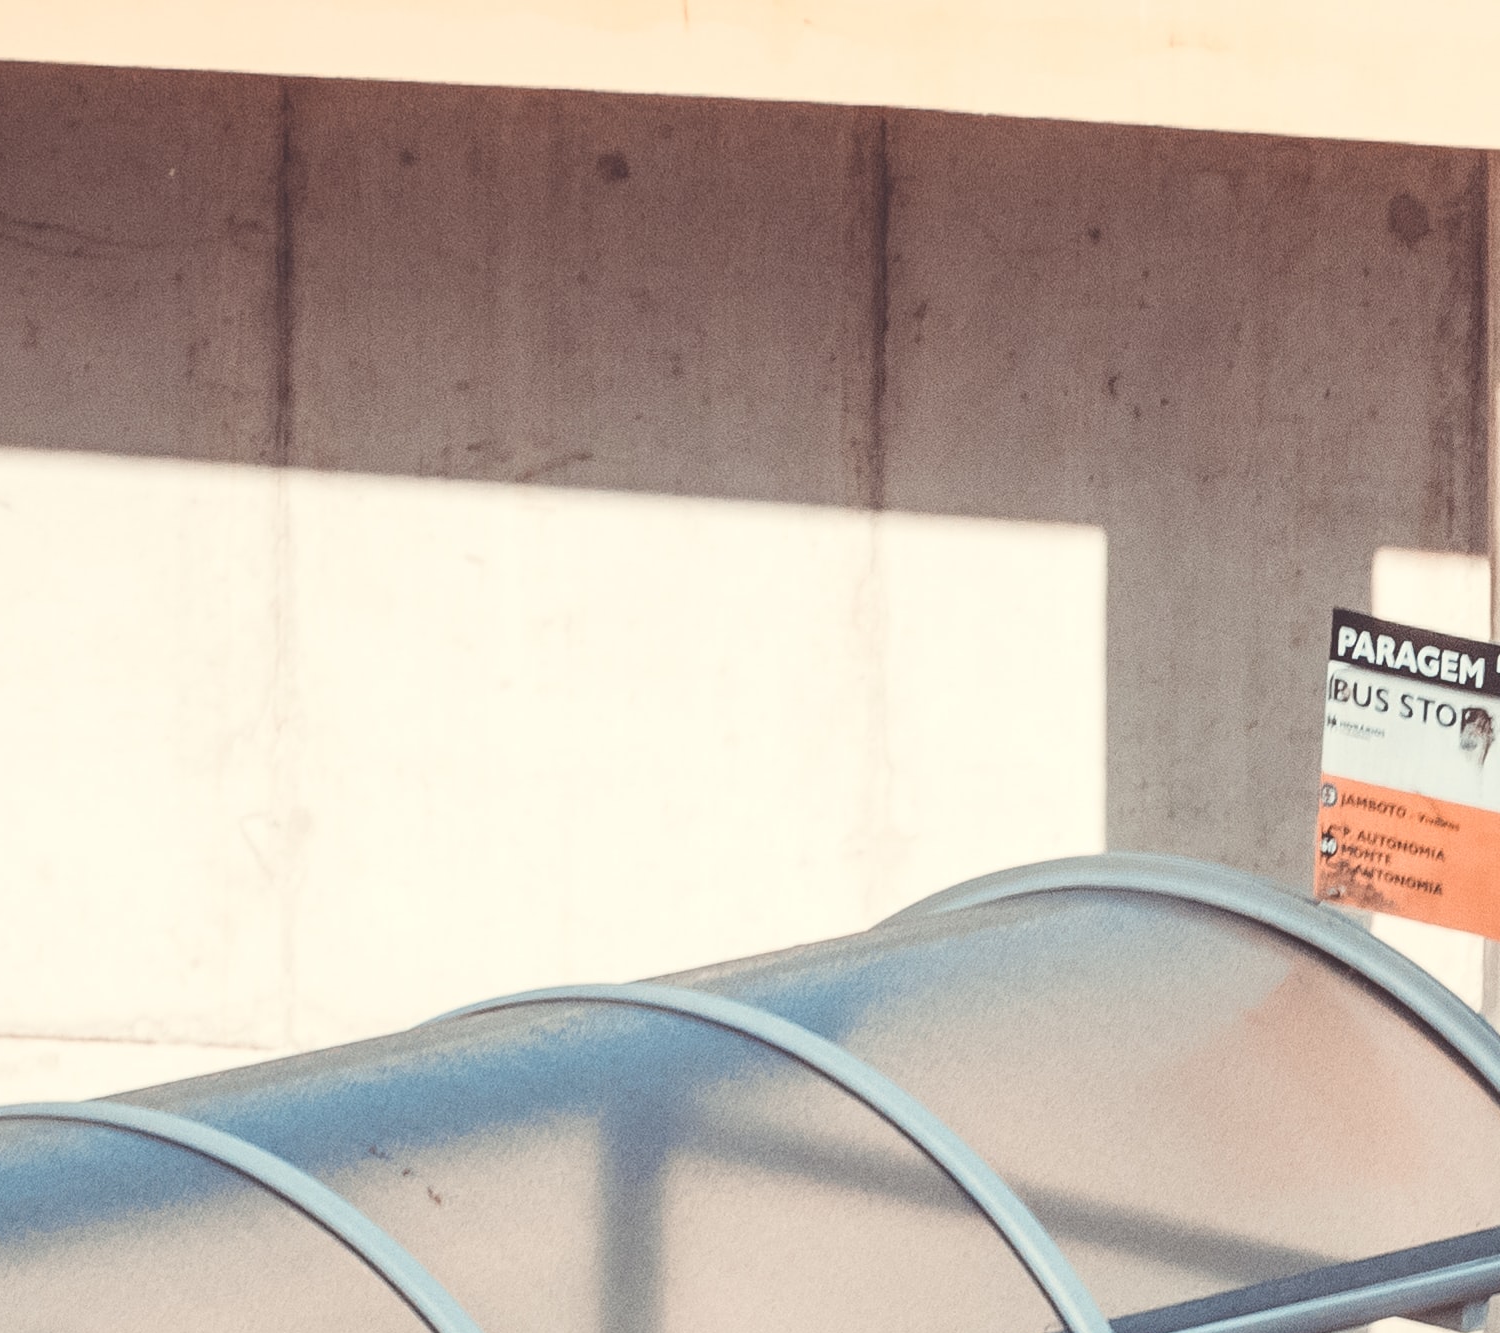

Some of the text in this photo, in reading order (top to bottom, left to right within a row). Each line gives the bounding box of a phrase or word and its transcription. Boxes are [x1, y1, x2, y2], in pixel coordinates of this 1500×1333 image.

[1337, 625, 1486, 689] PARAGEM
[1333, 677, 1390, 713] BUS
[1341, 843, 1393, 865] MONTE
[1356, 830, 1446, 862] AUTONOMIA
